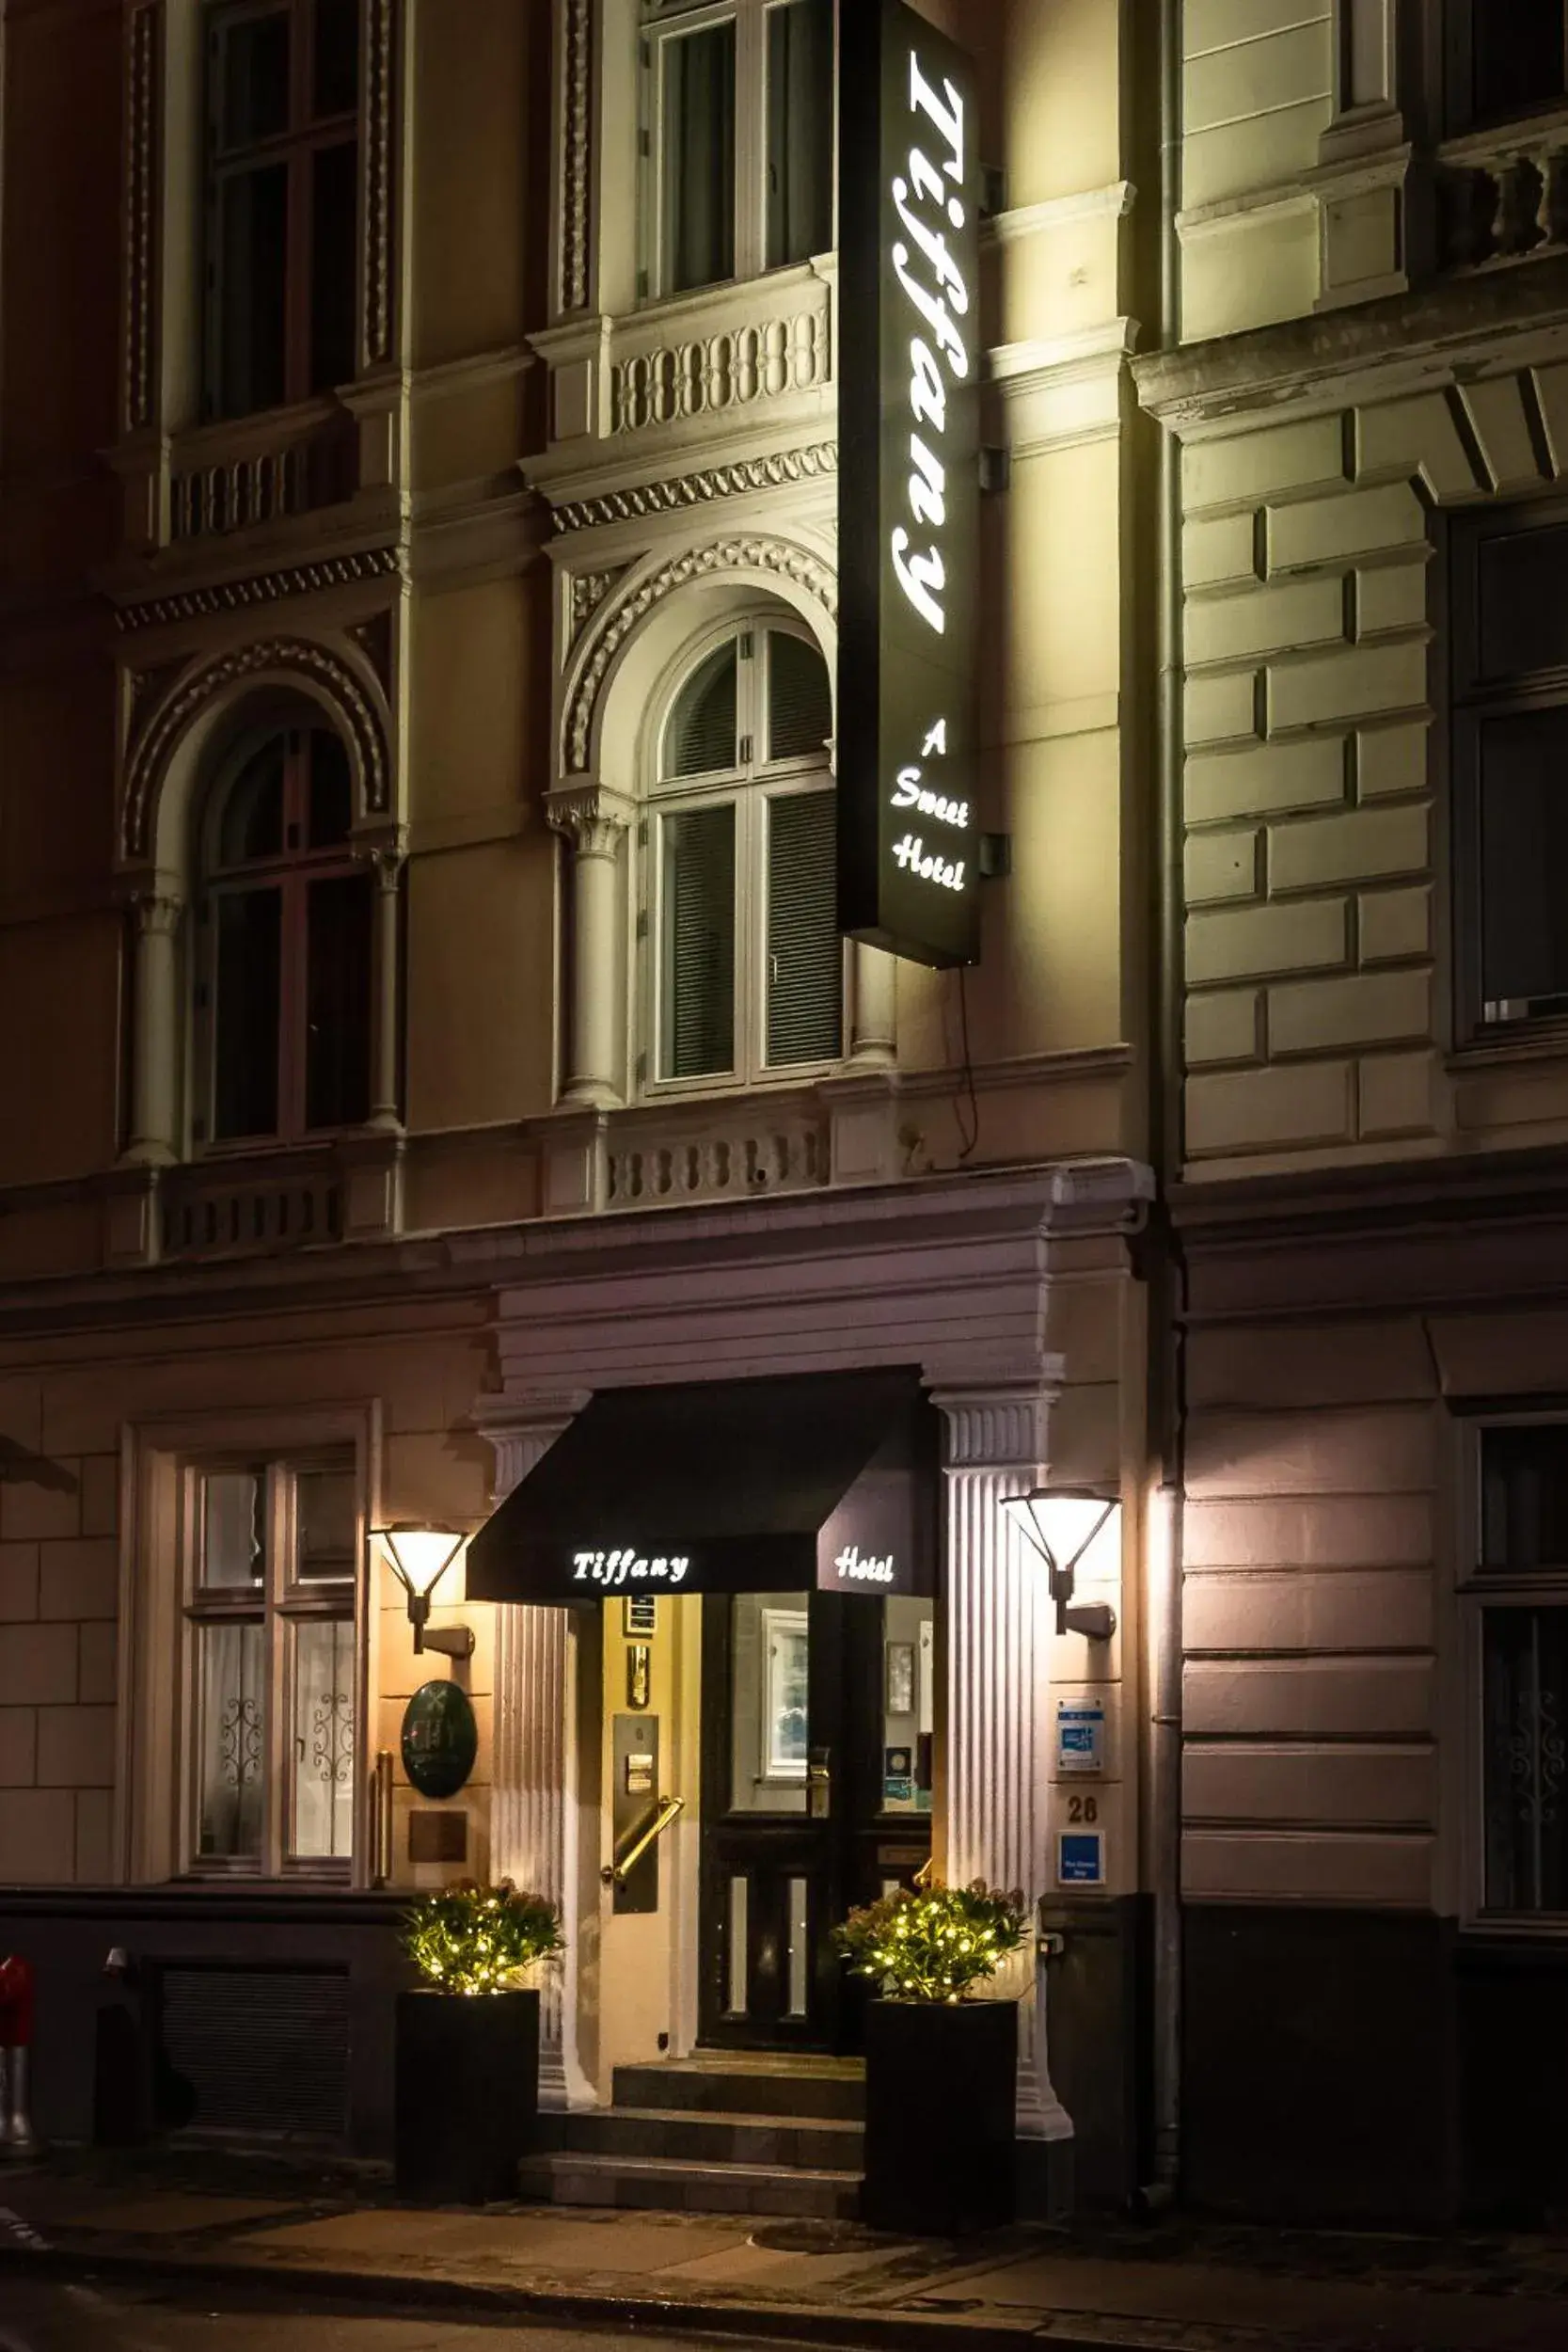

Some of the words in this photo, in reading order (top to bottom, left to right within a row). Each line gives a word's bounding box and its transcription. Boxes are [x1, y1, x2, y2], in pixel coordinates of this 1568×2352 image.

[891, 50, 969, 635] Tiffany
[921, 718, 946, 757] A
[892, 834, 965, 892] Hotel
[573, 1548, 689, 1585] Tiffany
[833, 1546, 894, 1582] Hotel
